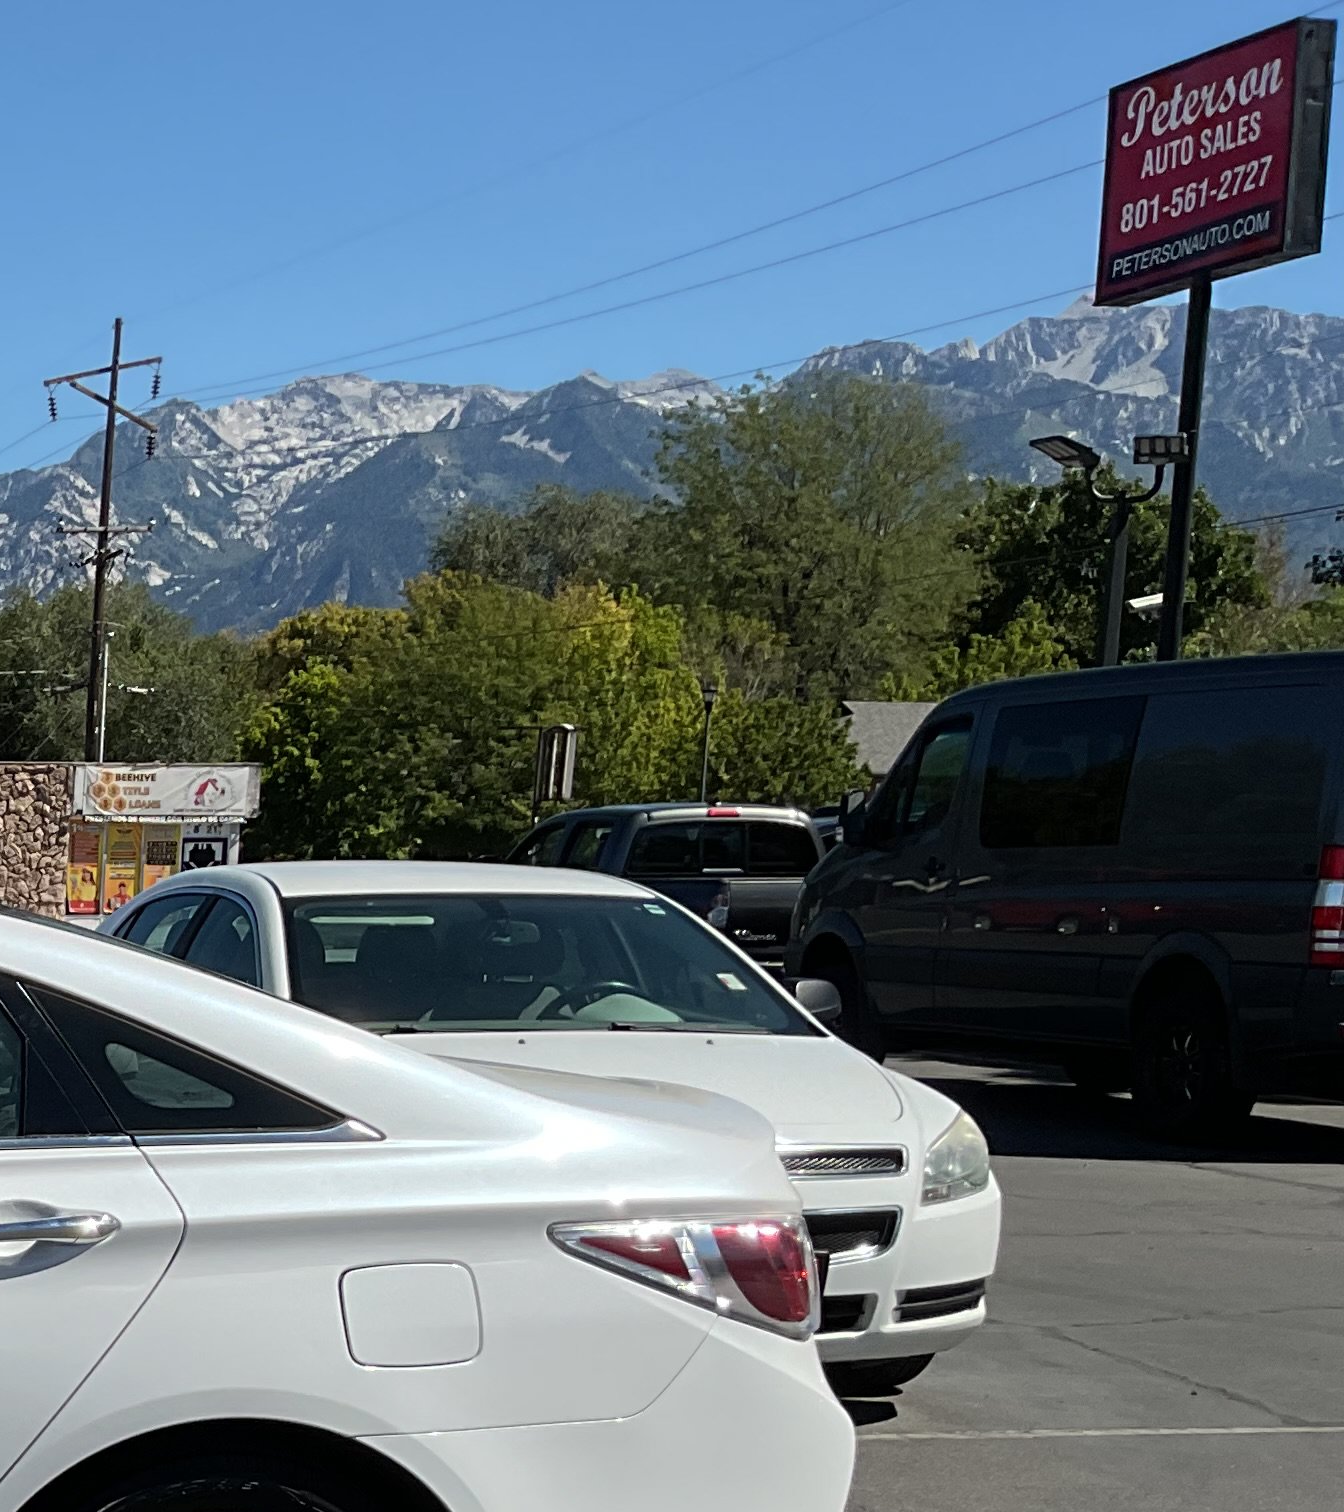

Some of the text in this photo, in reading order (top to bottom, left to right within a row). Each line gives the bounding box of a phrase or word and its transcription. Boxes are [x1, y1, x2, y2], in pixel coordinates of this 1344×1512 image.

[1120, 57, 1284, 148] Peterson
[1140, 111, 1262, 180] AUTO SALES
[1119, 154, 1273, 233] 801-561-2727
[1111, 210, 1271, 279] PETERSONAUTO.COM
[115, 773, 157, 782] BEEHIVE
